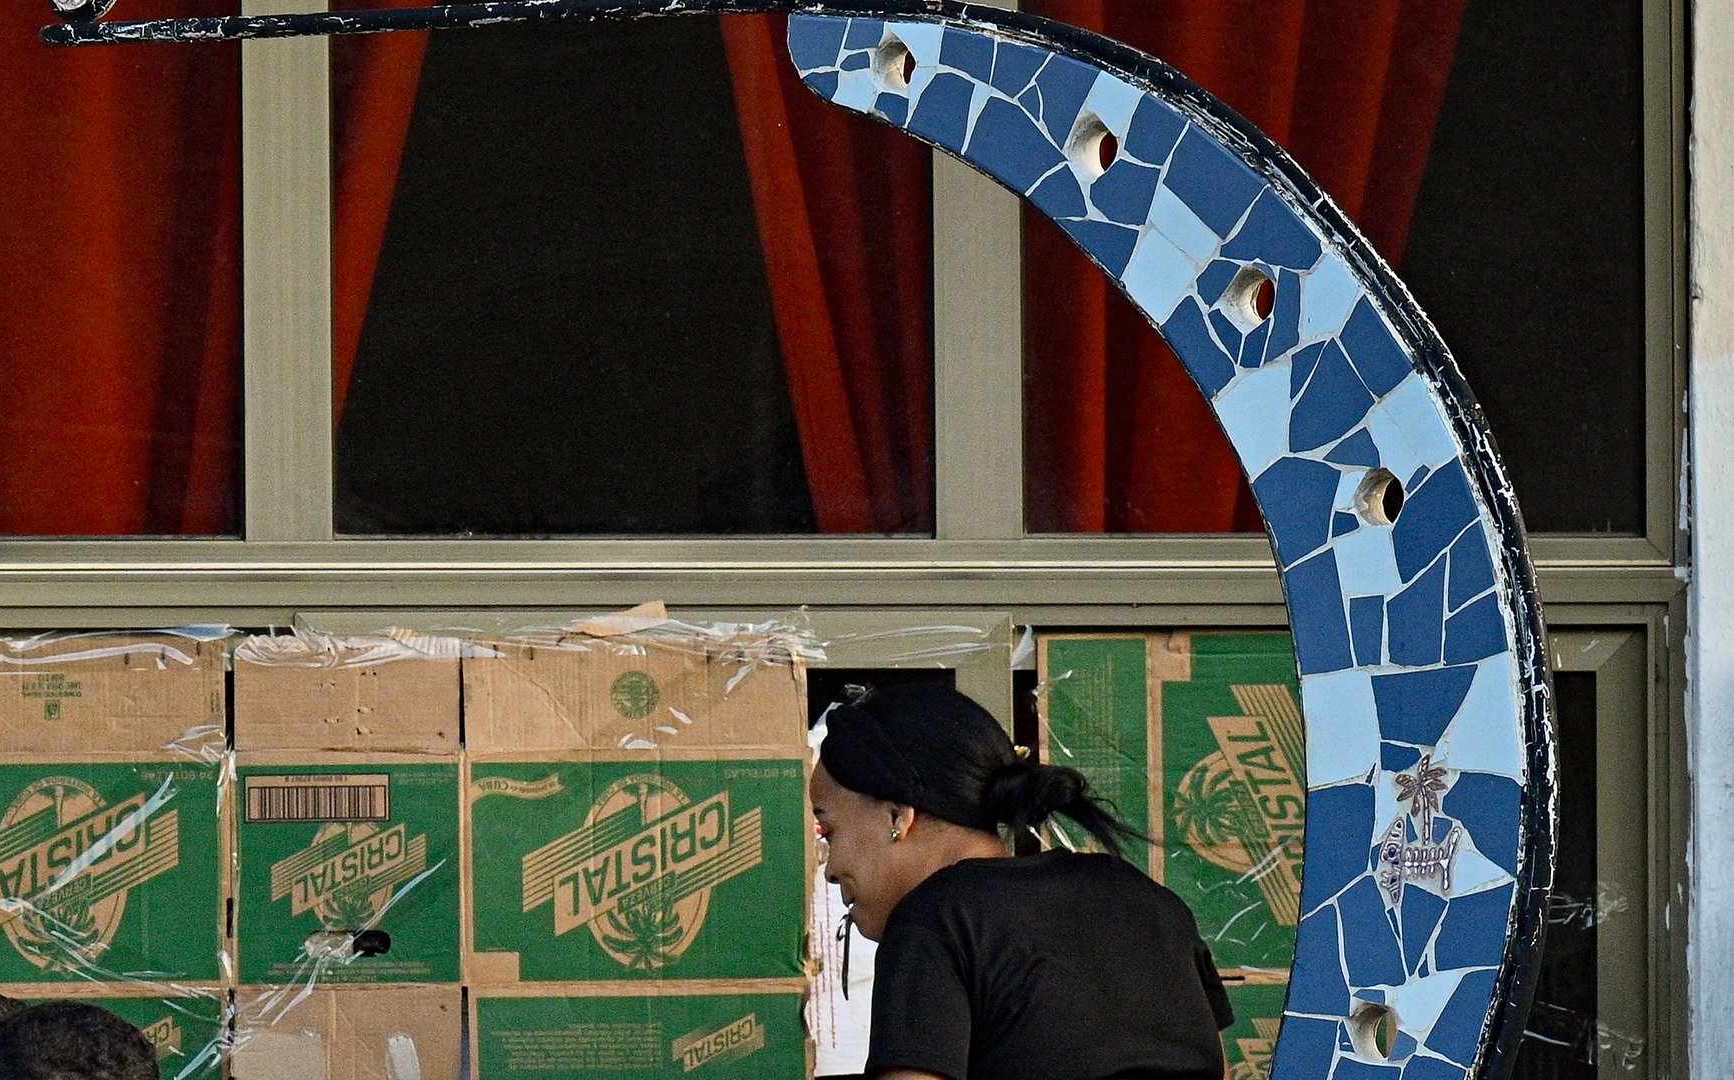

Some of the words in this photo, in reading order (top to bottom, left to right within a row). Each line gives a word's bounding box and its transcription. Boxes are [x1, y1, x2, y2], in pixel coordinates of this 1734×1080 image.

[294, 830, 403, 903] CRISTAL
[559, 801, 725, 916] CRISTAL
[682, 1020, 753, 1066] CRISTAL
